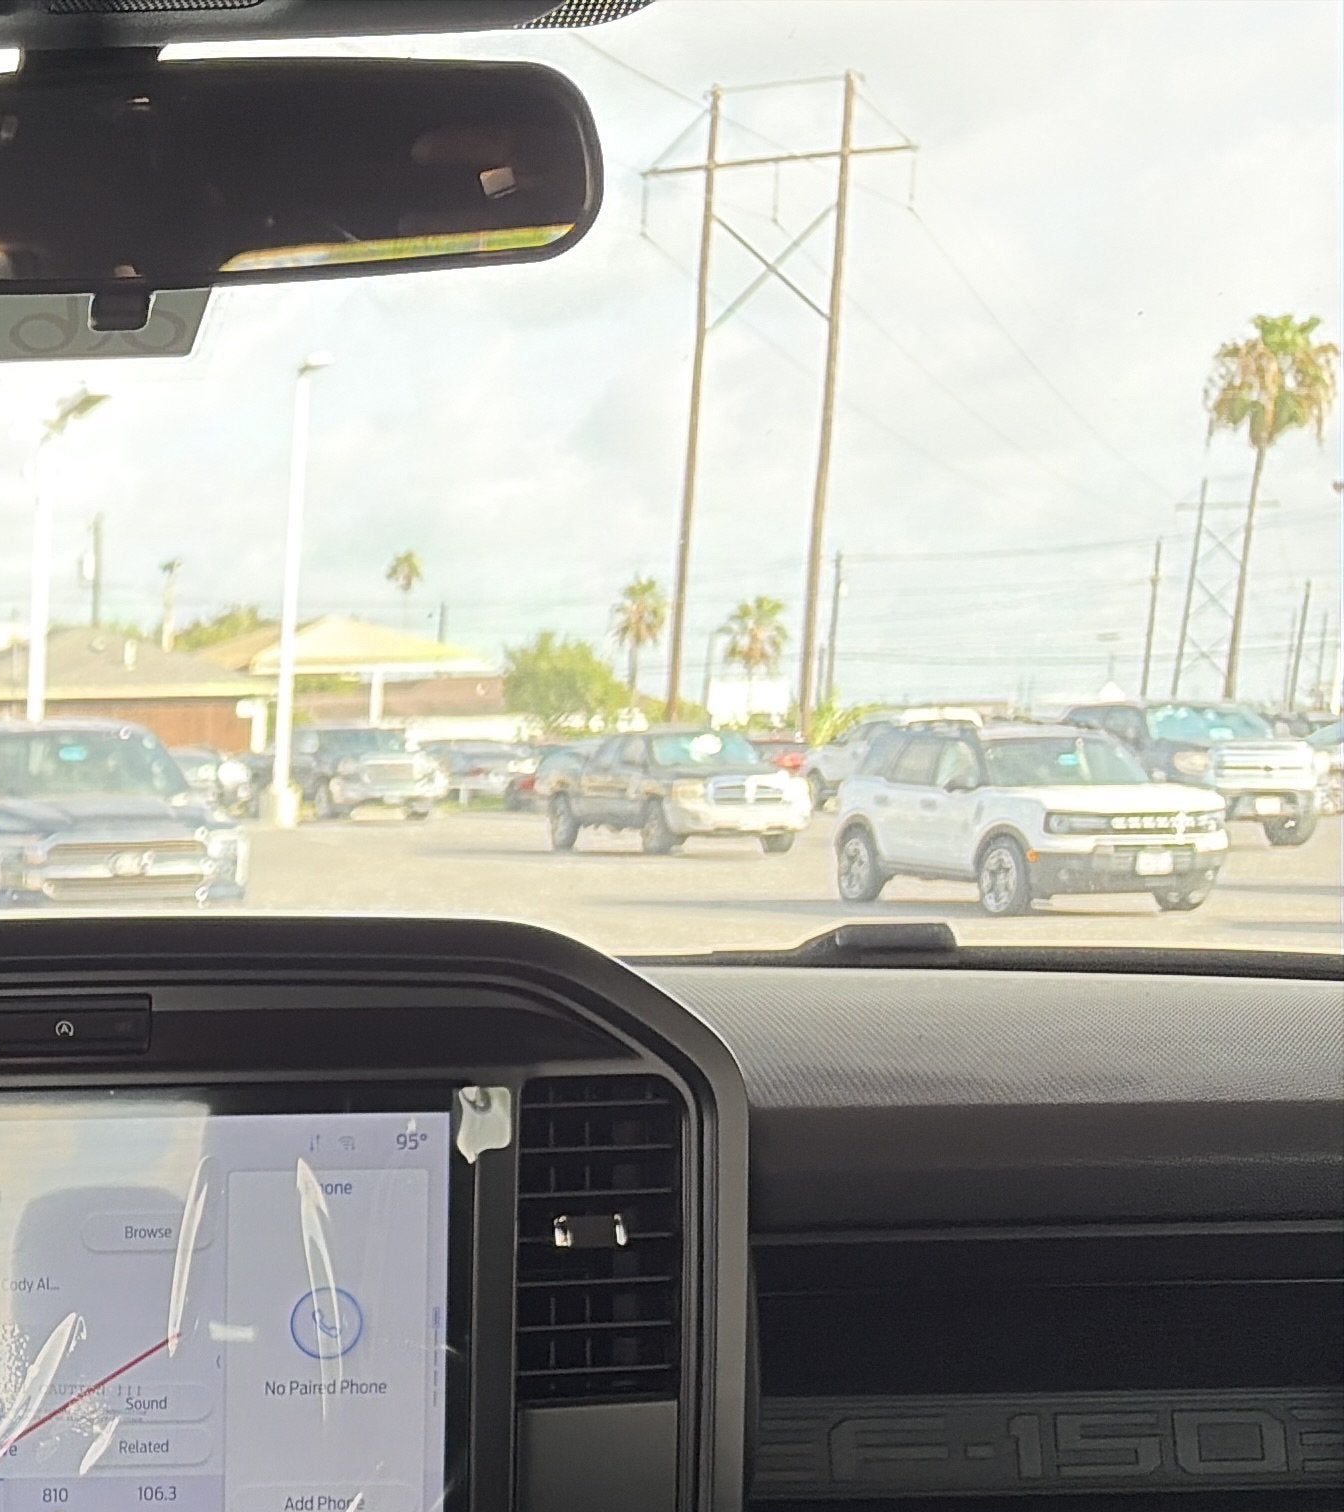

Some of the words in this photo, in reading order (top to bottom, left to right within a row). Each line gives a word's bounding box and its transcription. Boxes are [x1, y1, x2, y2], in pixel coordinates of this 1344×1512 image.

[124, 1224, 173, 1240] Browse
[0, 1277, 33, 1294] Cody
[264, 1381, 286, 1396] No
[290, 1380, 336, 1395] Paired
[340, 1379, 388, 1395] Phone
[125, 1397, 168, 1411] Sound
[118, 1439, 170, 1454] Related
[828, 1408, 1291, 1483] F-150
[42, 1487, 69, 1503] 810
[137, 1486, 177, 1502] 106.3
[284, 1496, 314, 1512] Add
[317, 1495, 365, 1511] Phone
